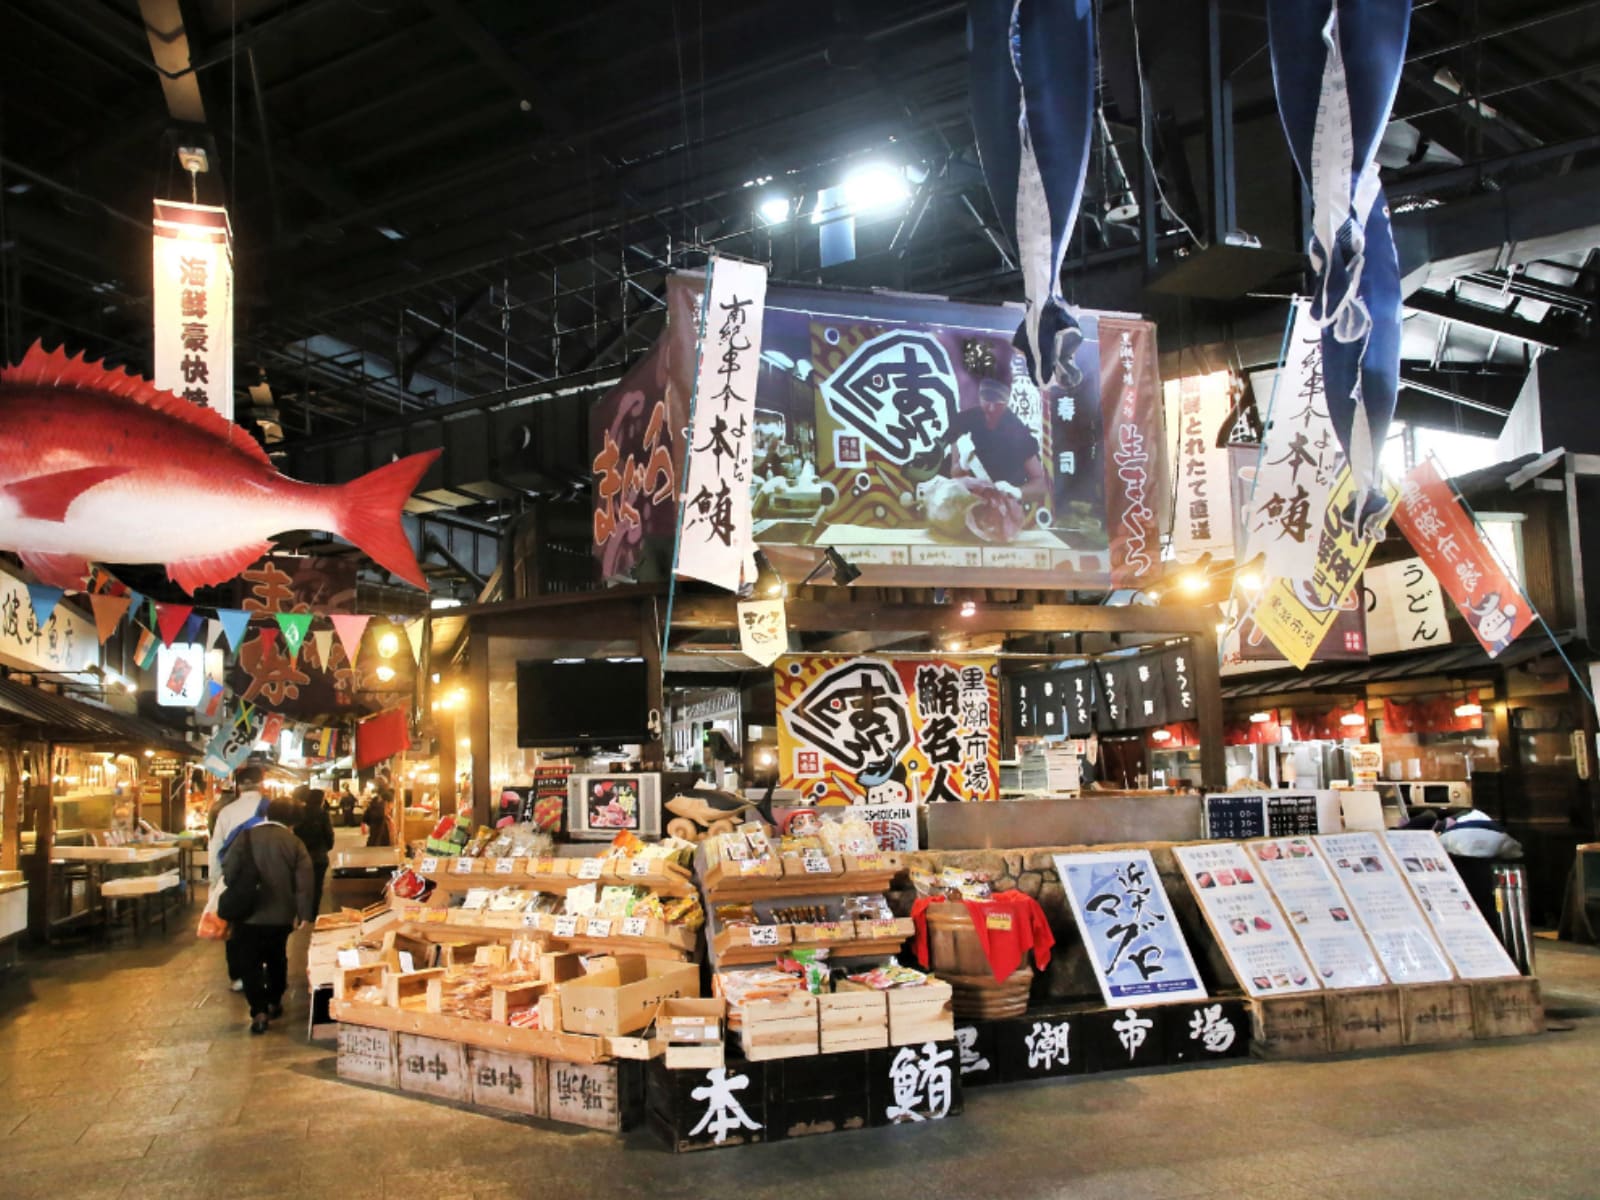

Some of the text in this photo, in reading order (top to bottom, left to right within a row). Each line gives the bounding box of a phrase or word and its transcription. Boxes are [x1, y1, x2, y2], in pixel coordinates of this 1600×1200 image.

[1402, 565, 1440, 642] うどん
[961, 668, 990, 793] 黒潮市場
